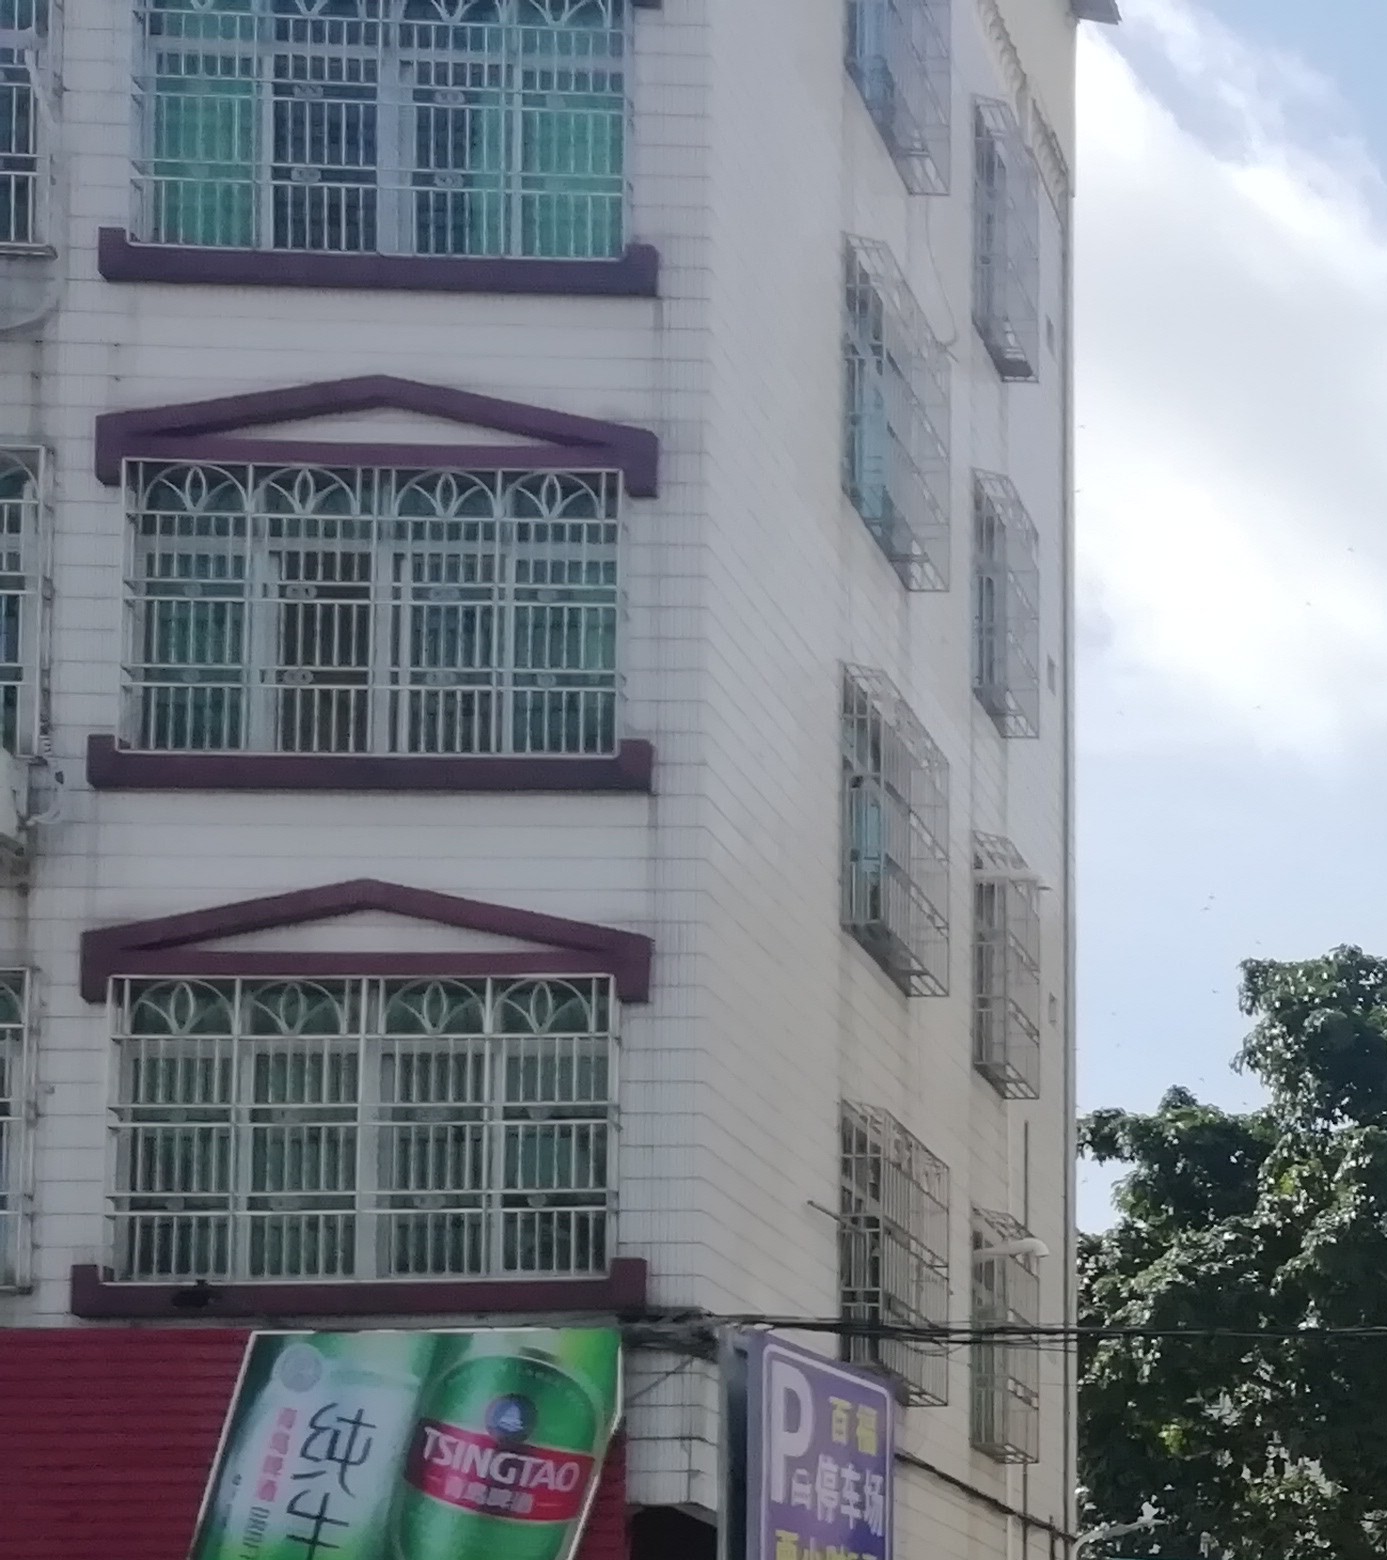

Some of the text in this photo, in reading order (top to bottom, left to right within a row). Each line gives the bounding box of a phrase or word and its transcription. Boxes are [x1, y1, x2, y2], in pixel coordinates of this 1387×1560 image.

[423, 1426, 580, 1492] TSINGTAO
[771, 1359, 814, 1504] P
[829, 1396, 878, 1457] 百福
[815, 1453, 885, 1538] 停车场
